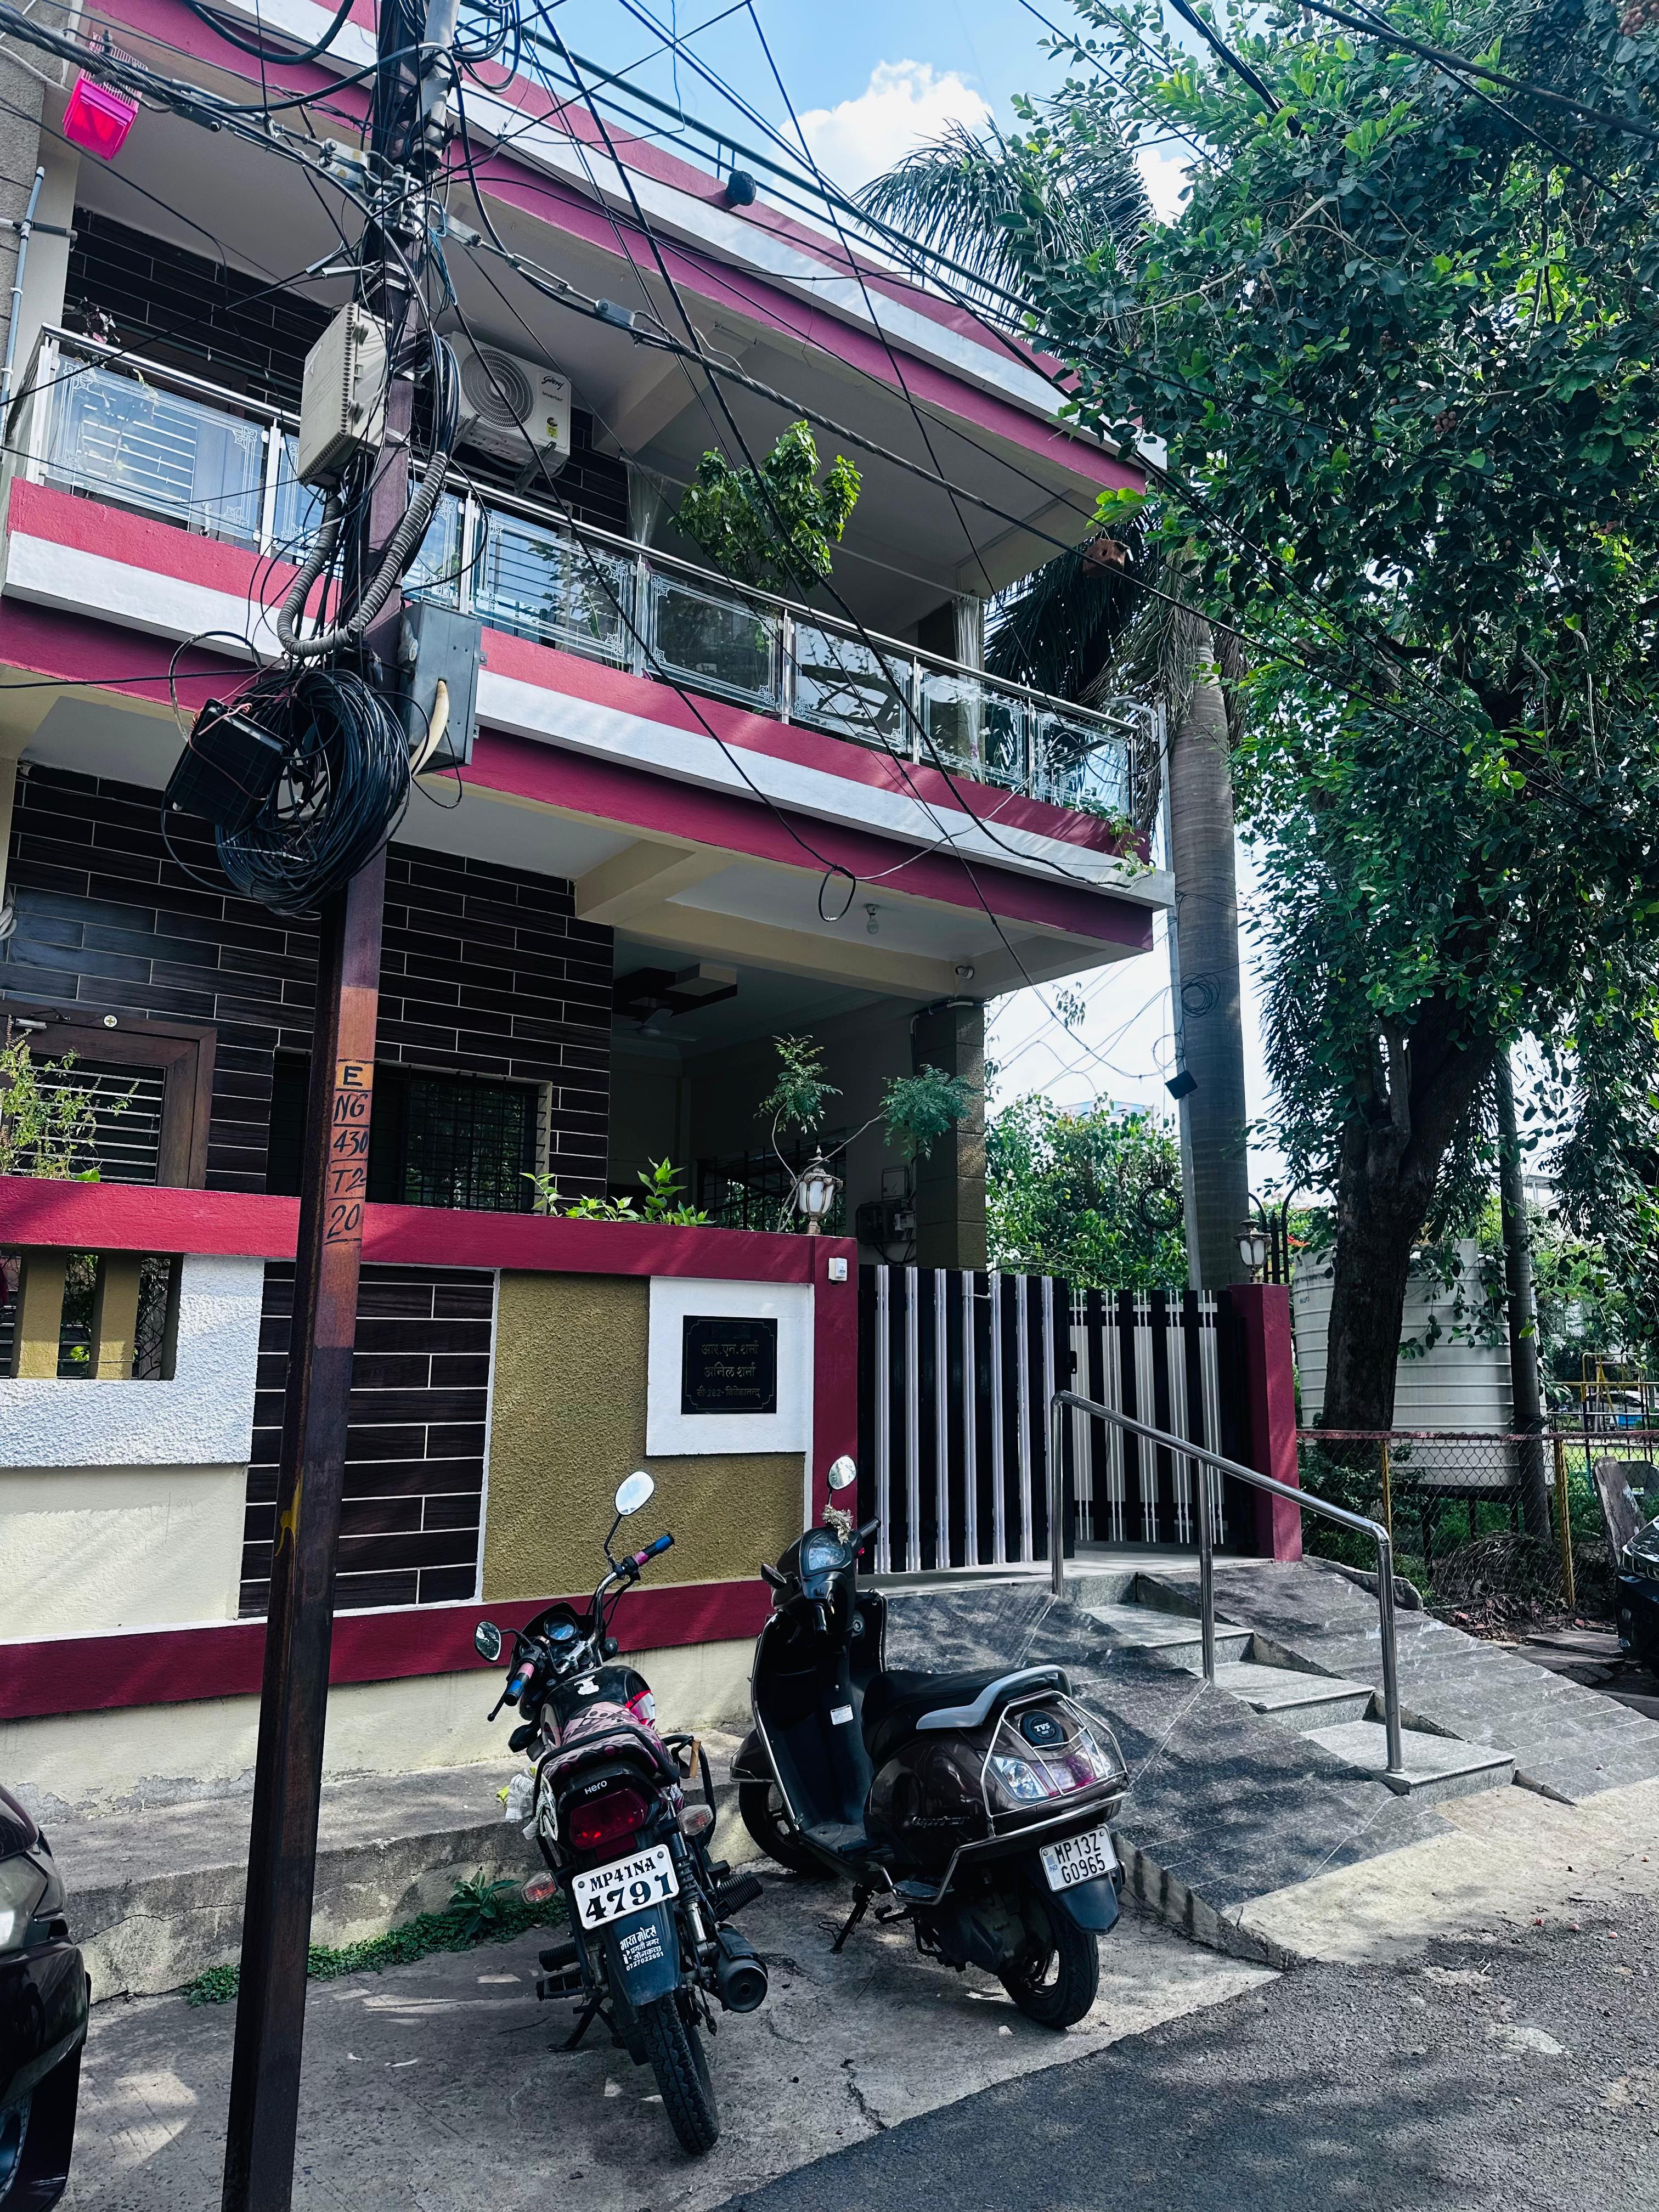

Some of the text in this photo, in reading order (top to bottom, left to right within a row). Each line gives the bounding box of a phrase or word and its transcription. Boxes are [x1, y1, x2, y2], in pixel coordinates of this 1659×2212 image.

[542, 391, 563, 402] Inverter
[343, 1066, 363, 1086] E
[333, 1093, 368, 1122] NG
[333, 1130, 368, 1157] 430
[327, 1203, 360, 1239] 20
[703, 1362, 757, 1378] अनिल शर्मा
[1034, 1723, 1051, 1732] TVS
[590, 1857, 656, 1892] MP41NA
[1048, 1864, 1058, 1872] IND
[1061, 1853, 1105, 1883] G0965
[586, 1872, 673, 1921] 4791
[619, 1933, 637, 1951] भारत
[645, 1938, 659, 1947] नगर
[626, 1951, 664, 1971] 0727022651
